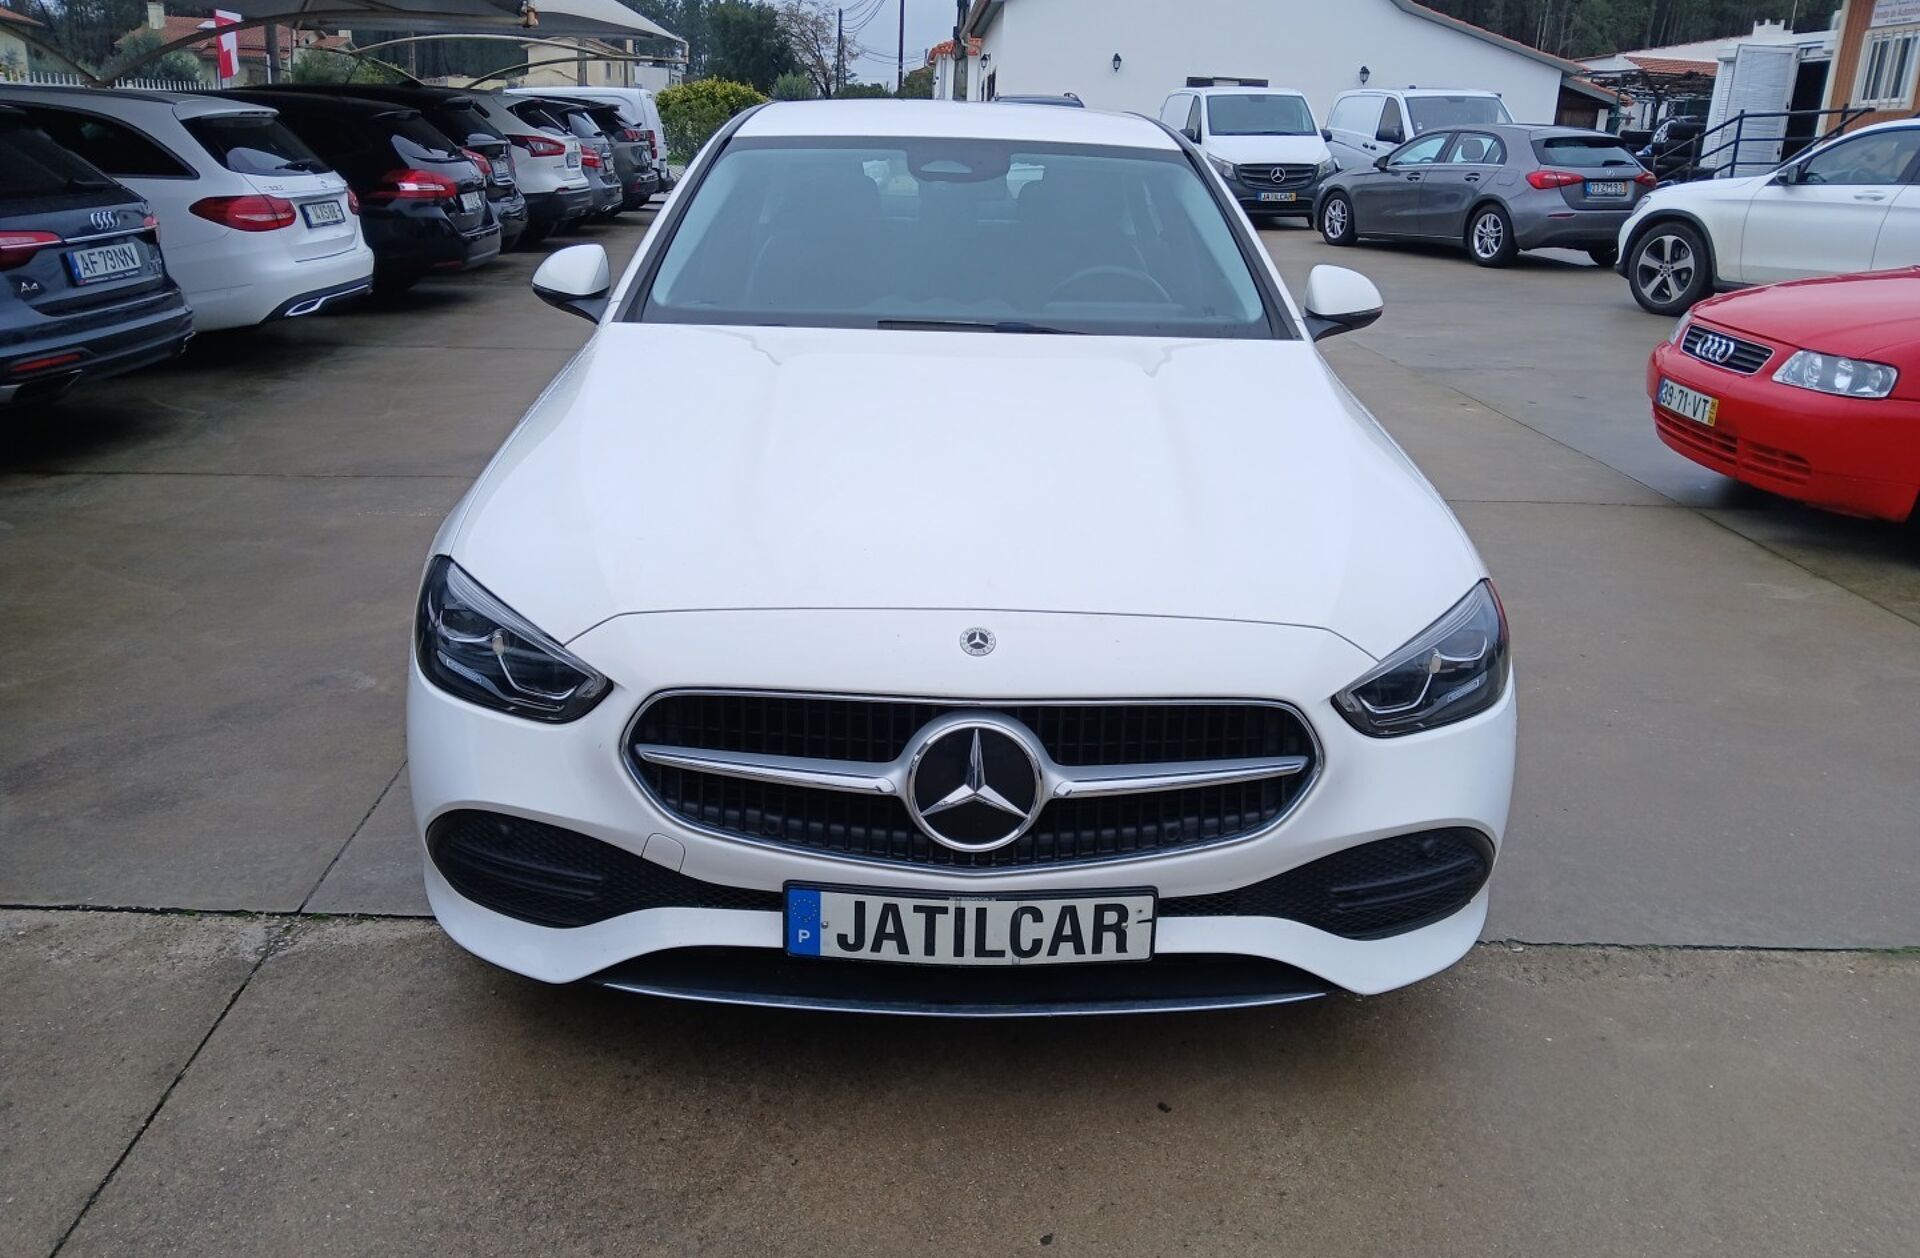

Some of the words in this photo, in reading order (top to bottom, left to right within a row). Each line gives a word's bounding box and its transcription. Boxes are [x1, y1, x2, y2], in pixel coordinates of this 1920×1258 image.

[20, 281, 39, 293] A4
[798, 929, 810, 943] P
[836, 900, 1129, 958] JATILCAR
